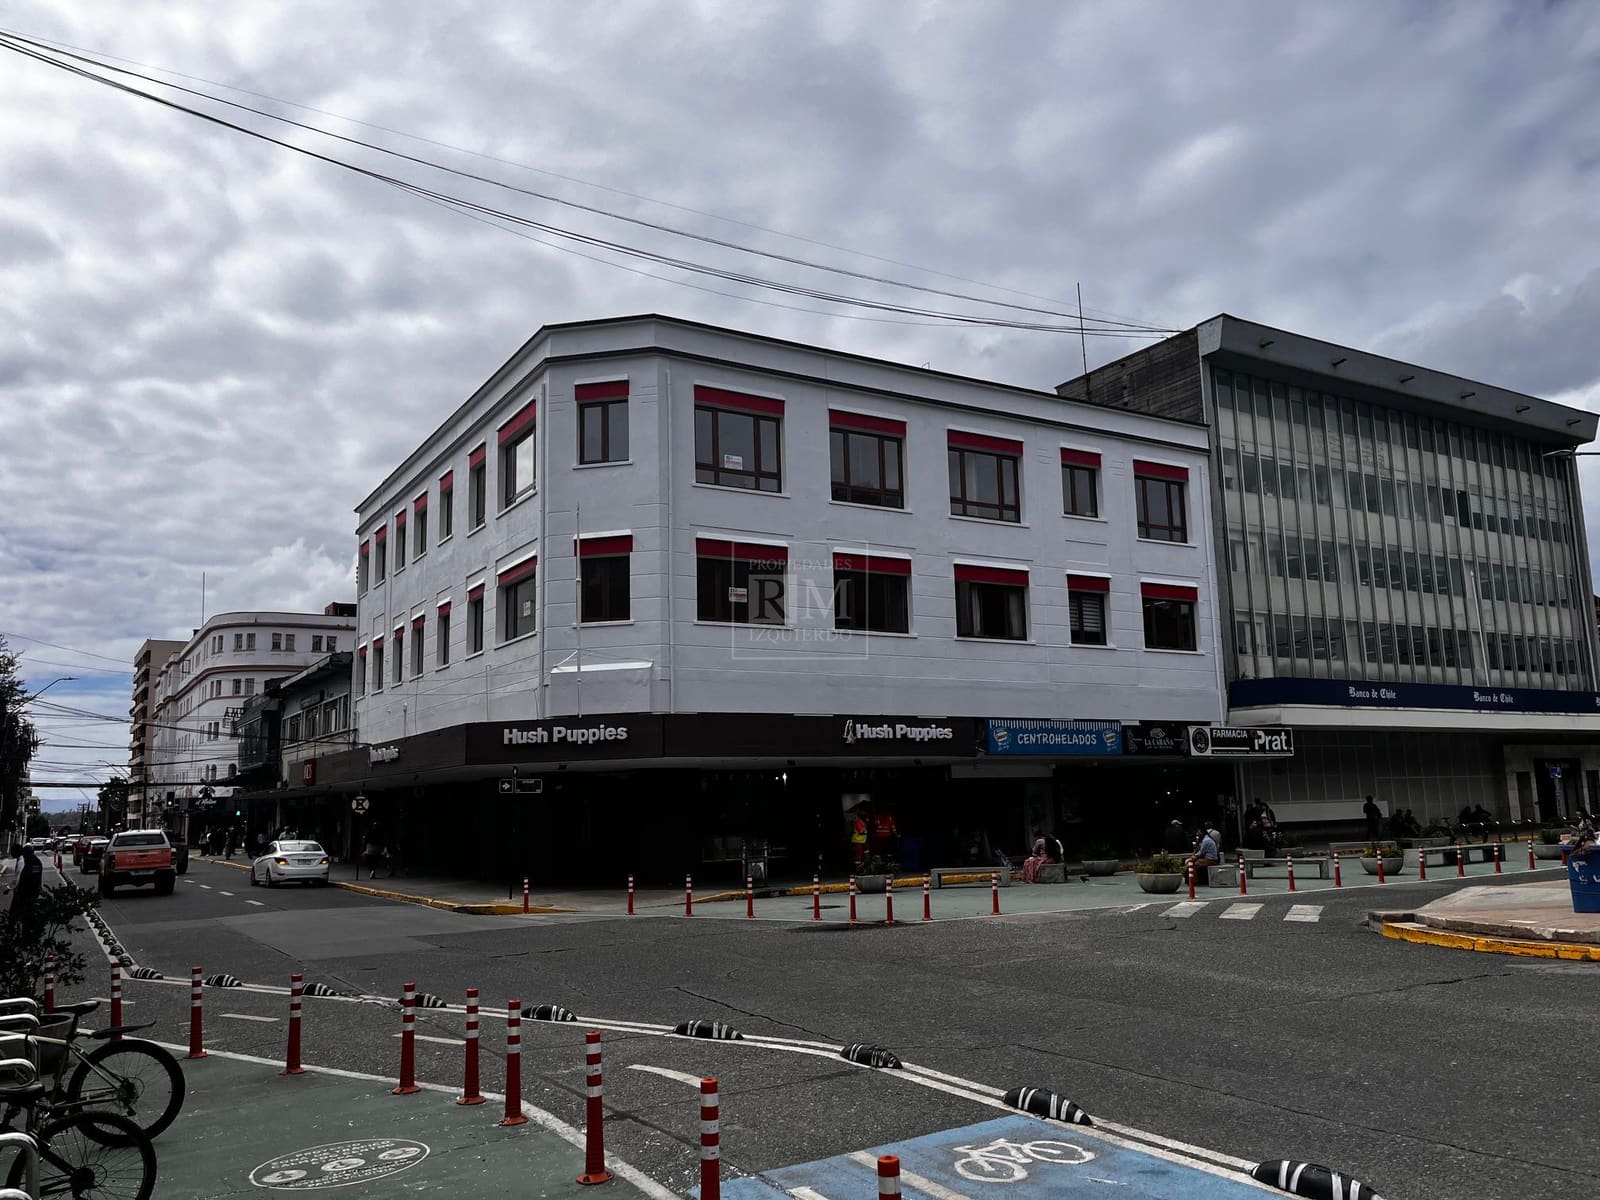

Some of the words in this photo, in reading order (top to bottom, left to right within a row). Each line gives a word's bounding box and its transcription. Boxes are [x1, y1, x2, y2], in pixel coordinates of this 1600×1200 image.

[1348, 686, 1370, 698] Banco
[1380, 688, 1397, 699] Chile
[1473, 691, 1491, 702] Banco
[1500, 692, 1514, 704] Chile
[503, 728, 548, 744] Hush
[553, 724, 628, 744] Puppies
[855, 724, 893, 738] Hush
[896, 724, 953, 741] Puppies
[1017, 733, 1096, 745] CENTROHELADOS
[1212, 730, 1248, 738] FARMACIA
